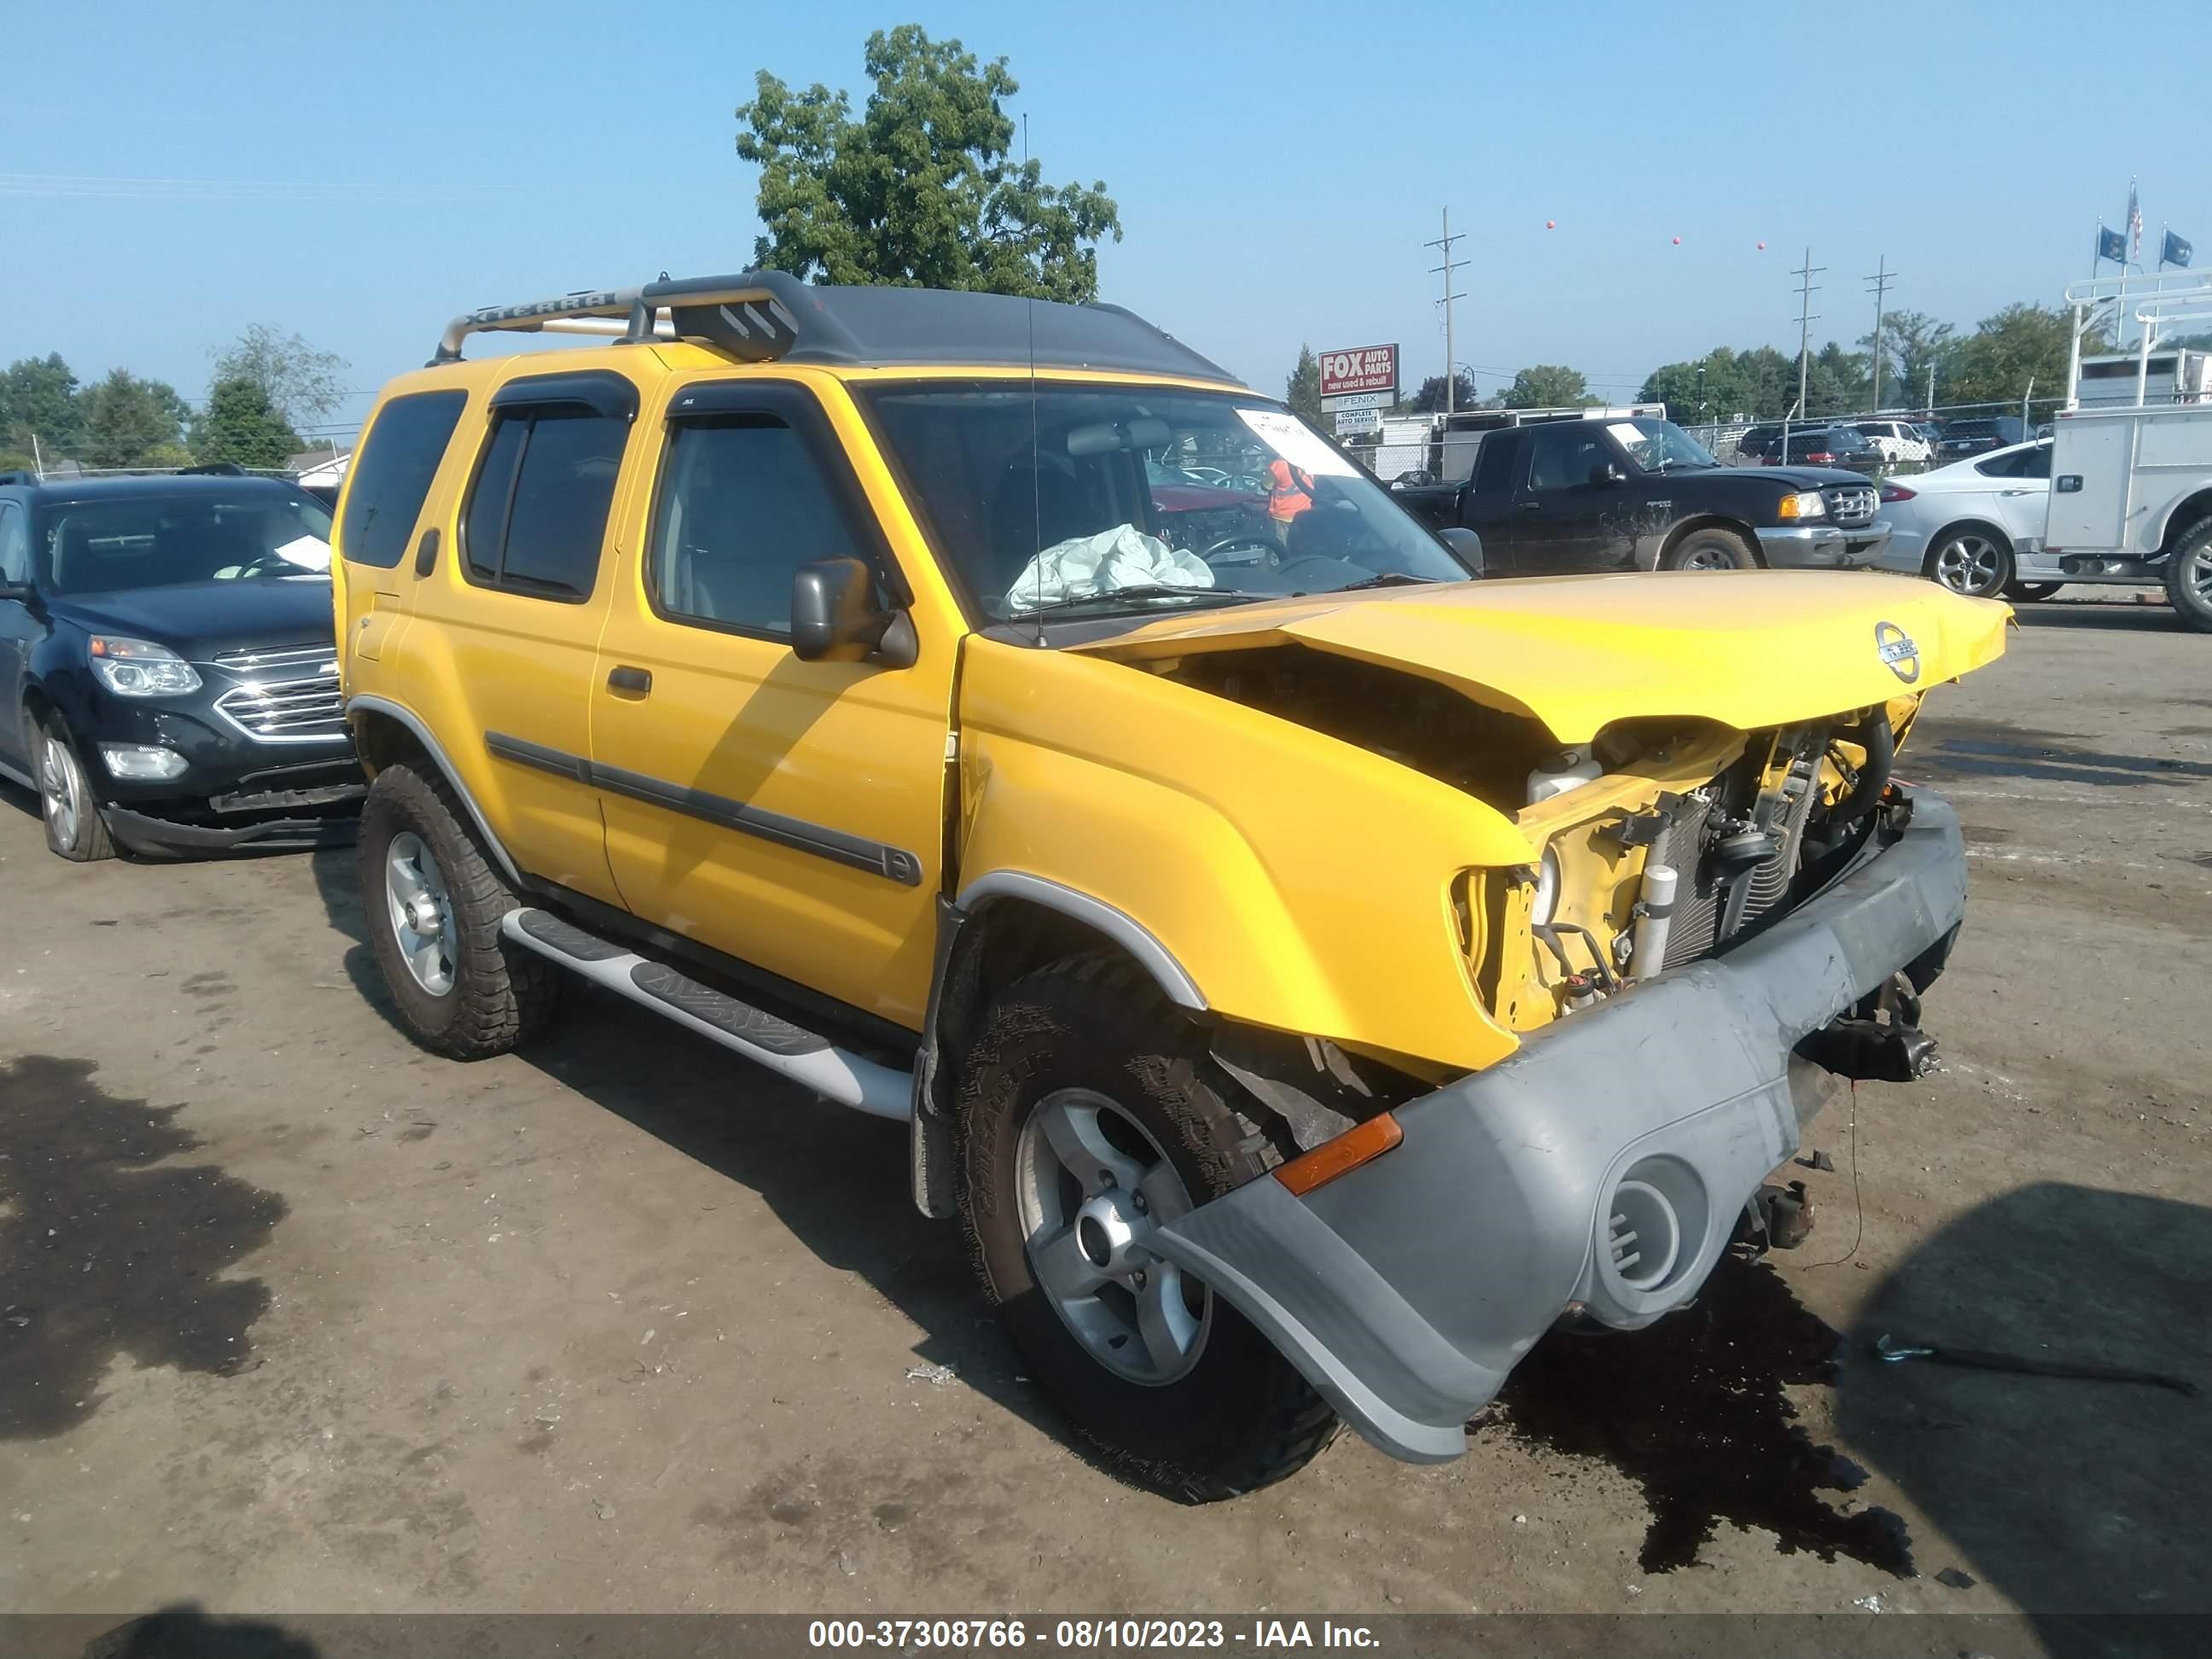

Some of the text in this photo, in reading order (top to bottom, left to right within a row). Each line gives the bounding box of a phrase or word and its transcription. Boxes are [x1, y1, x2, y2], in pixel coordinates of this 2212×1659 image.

[464, 294, 607, 325] XTERRA
[1323, 349, 1388, 380] FOX AUTO
[1365, 361, 1392, 375] PARTS
[1328, 375, 1387, 390] new used & rebuilt
[1343, 394, 1378, 405] FENIX
[1342, 410, 1372, 419] COMPLETE
[1354, 416, 1378, 425] SERVICE
